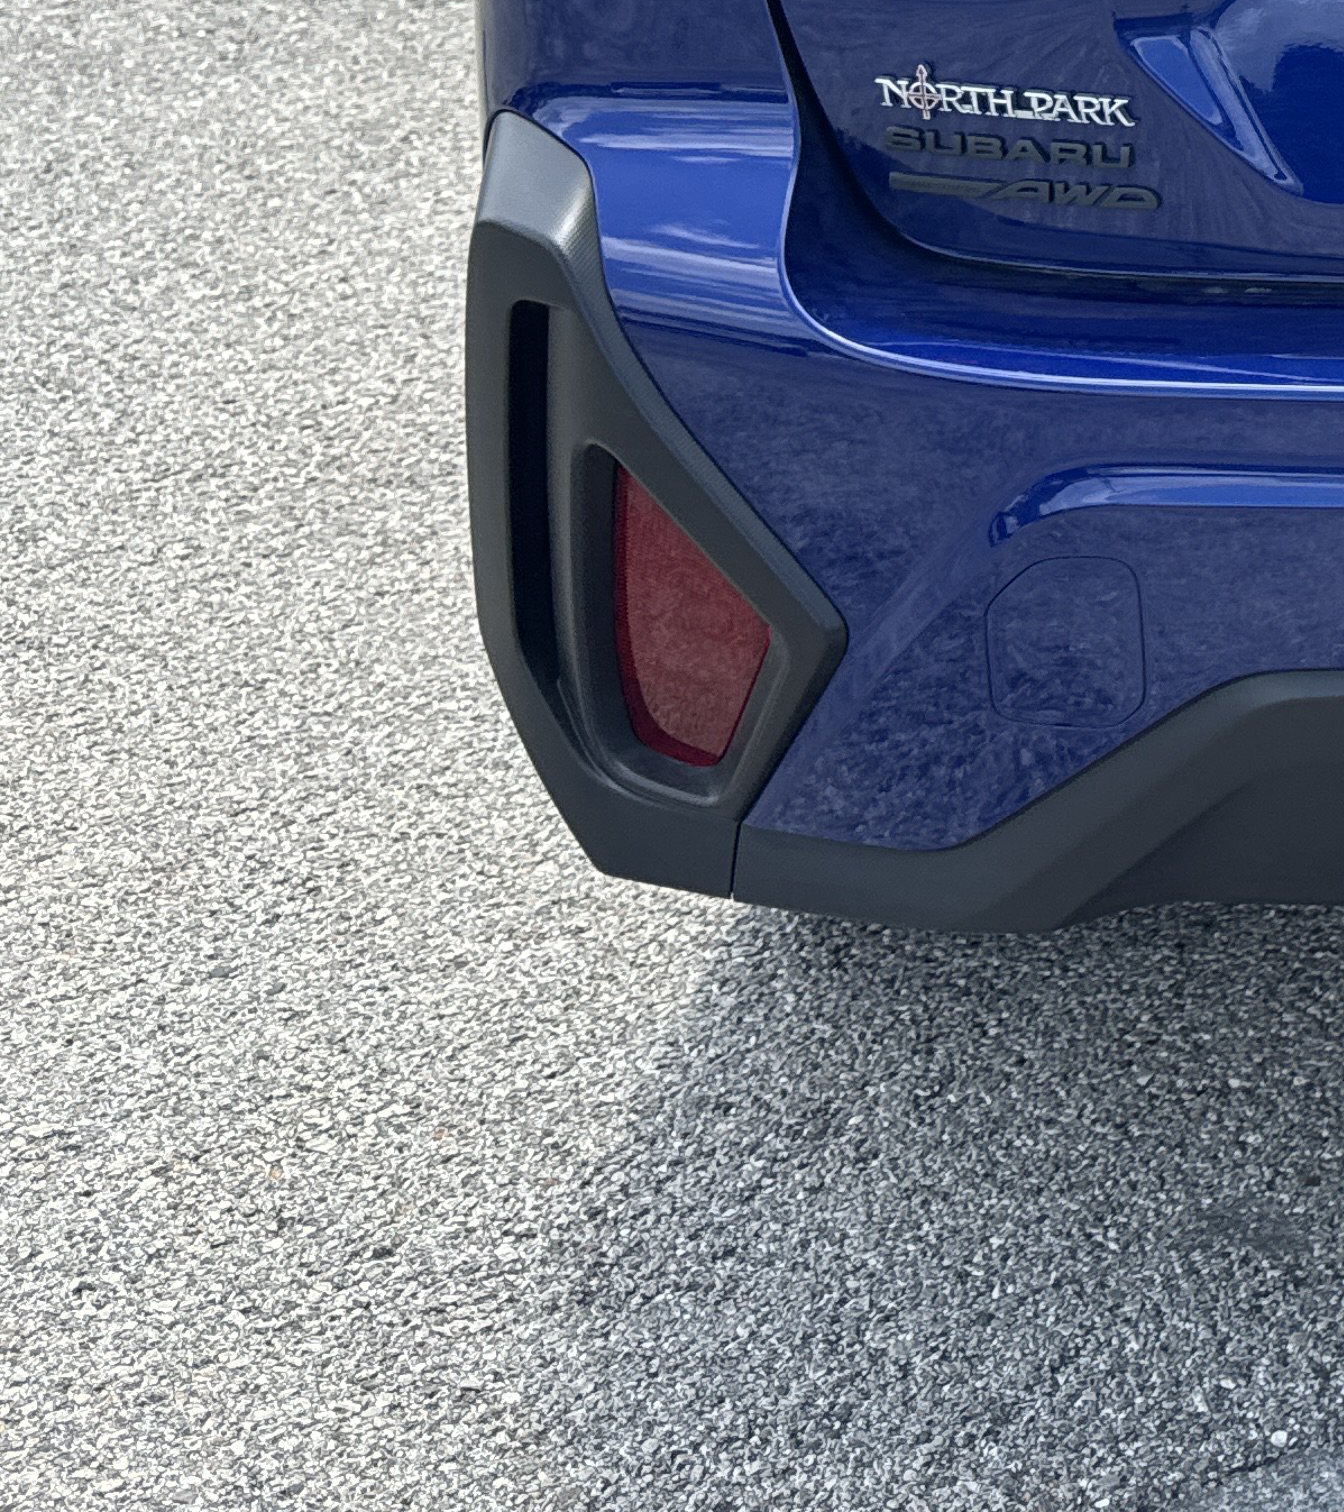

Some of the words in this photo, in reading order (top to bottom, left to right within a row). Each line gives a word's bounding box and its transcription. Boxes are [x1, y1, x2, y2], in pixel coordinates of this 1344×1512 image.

[1023, 89, 1136, 127] PARK
[884, 126, 1133, 169] SUBARU
[986, 178, 1161, 211] AWD
